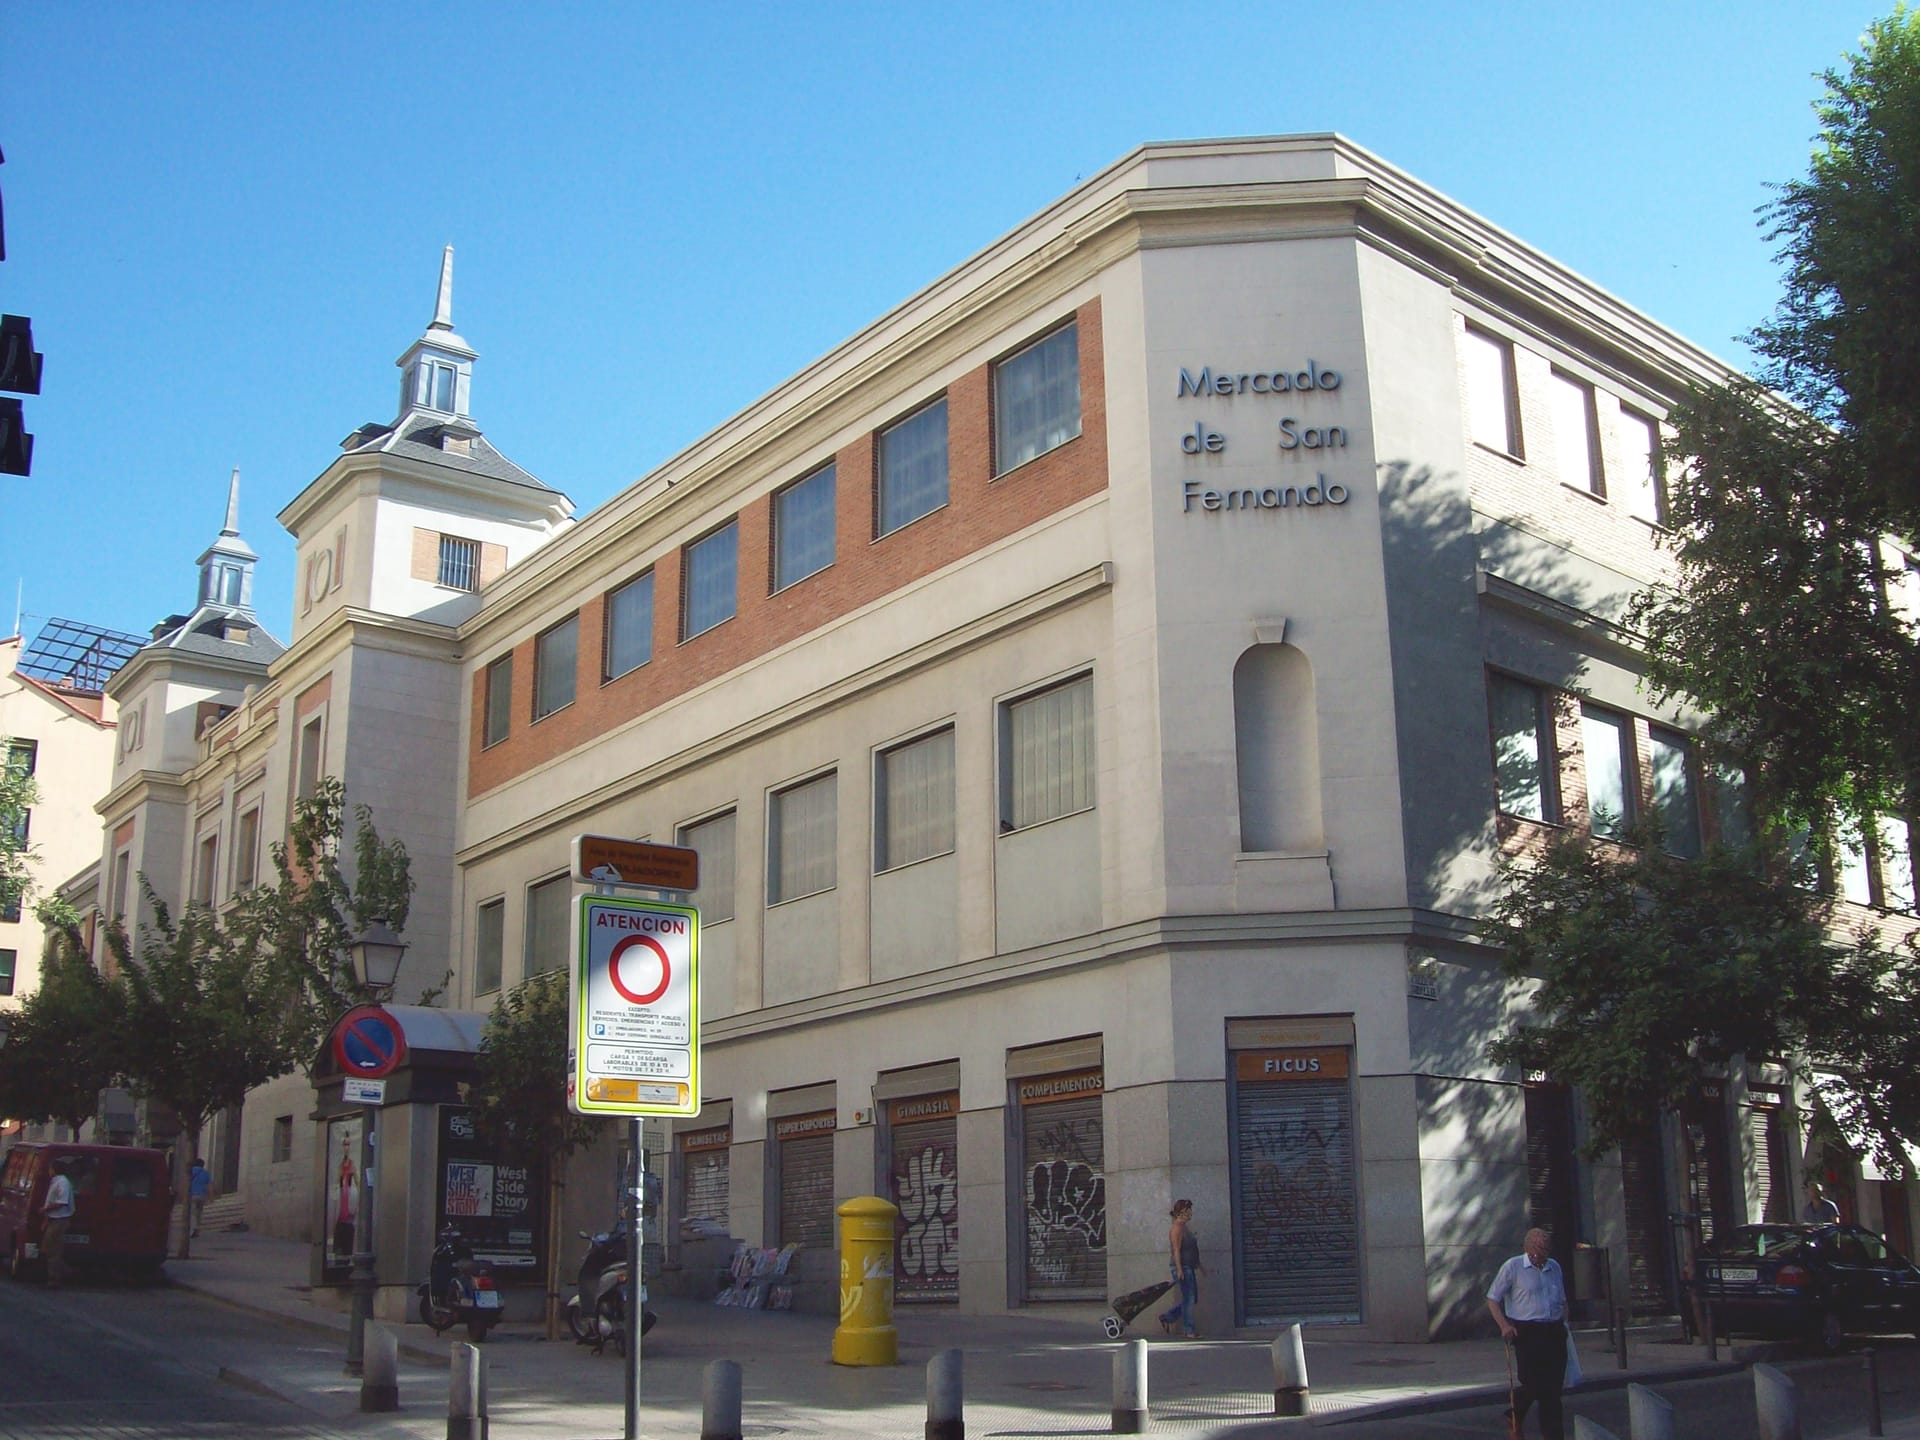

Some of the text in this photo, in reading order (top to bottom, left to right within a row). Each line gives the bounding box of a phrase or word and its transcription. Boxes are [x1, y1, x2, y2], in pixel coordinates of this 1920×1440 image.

[1178, 358, 1341, 398] Mercado
[1180, 417, 1347, 454] de San
[1181, 472, 1348, 512] Fernando
[596, 912, 685, 934] ATENCION
[1264, 1058, 1321, 1073] FICUS
[1020, 1076, 1103, 1098] COMPLEMENTOS
[896, 1100, 950, 1119] GIMNASIA
[687, 1131, 728, 1147] CAMISETAS
[496, 1165, 528, 1181] West
[495, 1179, 525, 1194] Side
[495, 1193, 529, 1211] Story
